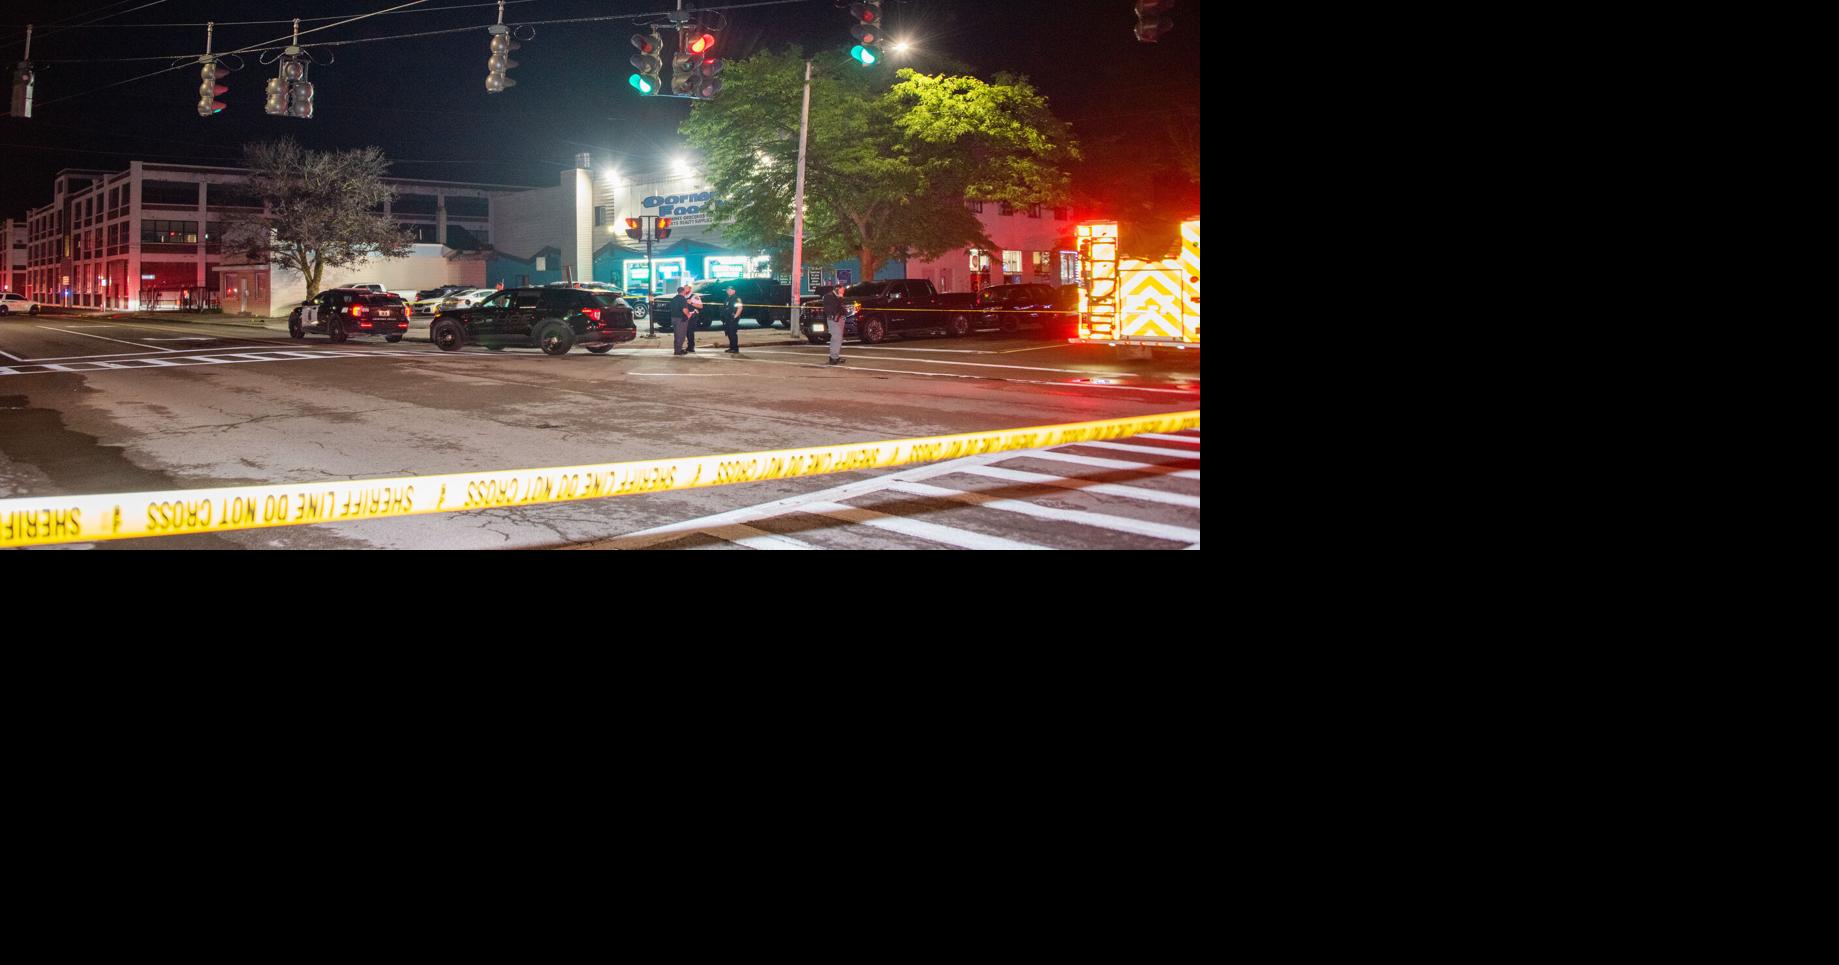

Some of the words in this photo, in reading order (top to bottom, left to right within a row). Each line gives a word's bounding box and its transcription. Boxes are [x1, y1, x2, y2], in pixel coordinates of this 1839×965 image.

[659, 203, 712, 217] Foo
[463, 477, 519, 507] CROSS
[521, 475, 554, 502] NOT
[556, 473, 579, 498] DO
[146, 498, 212, 531] CROSS
[219, 495, 257, 525] NOT
[264, 494, 289, 522] DO
[296, 491, 335, 519] LINE
[340, 485, 415, 517] SHERIFF
[0, 506, 81, 540] SHERIF
